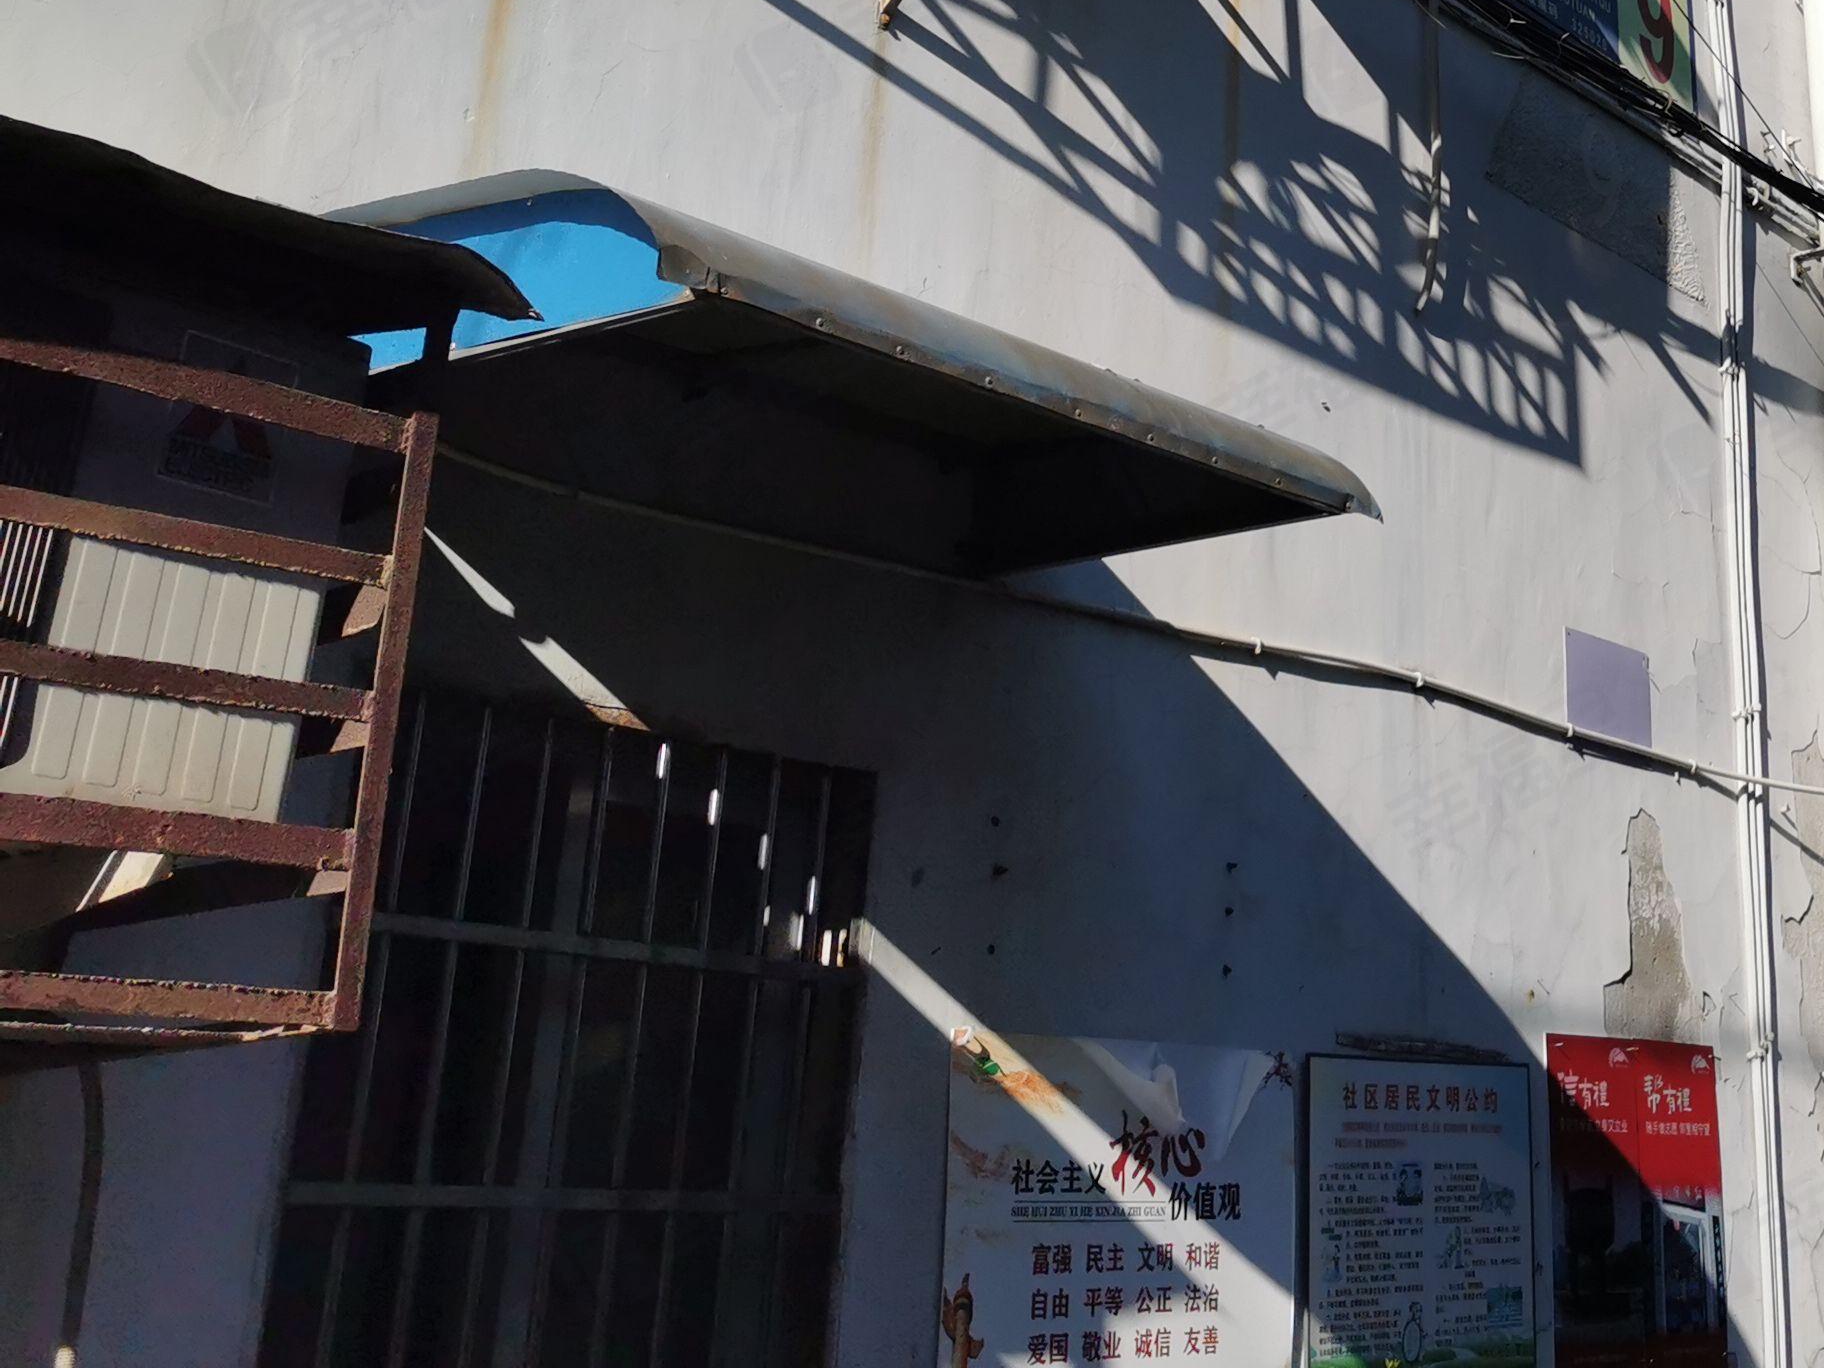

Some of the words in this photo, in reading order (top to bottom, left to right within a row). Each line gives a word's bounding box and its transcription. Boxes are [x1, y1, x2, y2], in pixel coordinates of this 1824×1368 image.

[1342, 1081, 1499, 1114] 社区居民文明公约
[1110, 1110, 1206, 1197] 核心
[1011, 1159, 1107, 1195] 社会主义
[1169, 1181, 1242, 1221] 价值观
[1032, 1242, 1072, 1275] 富强
[1085, 1243, 1124, 1273] 民主
[1137, 1242, 1173, 1271] 文明
[1184, 1242, 1220, 1271] 和谐
[1030, 1288, 1069, 1320] 自由
[1083, 1286, 1124, 1317] 平等
[1135, 1287, 1172, 1314] 公正
[1184, 1285, 1219, 1313] 法治
[1027, 1332, 1069, 1364] 爱国
[1081, 1330, 1121, 1362] 敬业
[1134, 1327, 1171, 1358] 诚信
[1183, 1325, 1219, 1356] 友善
